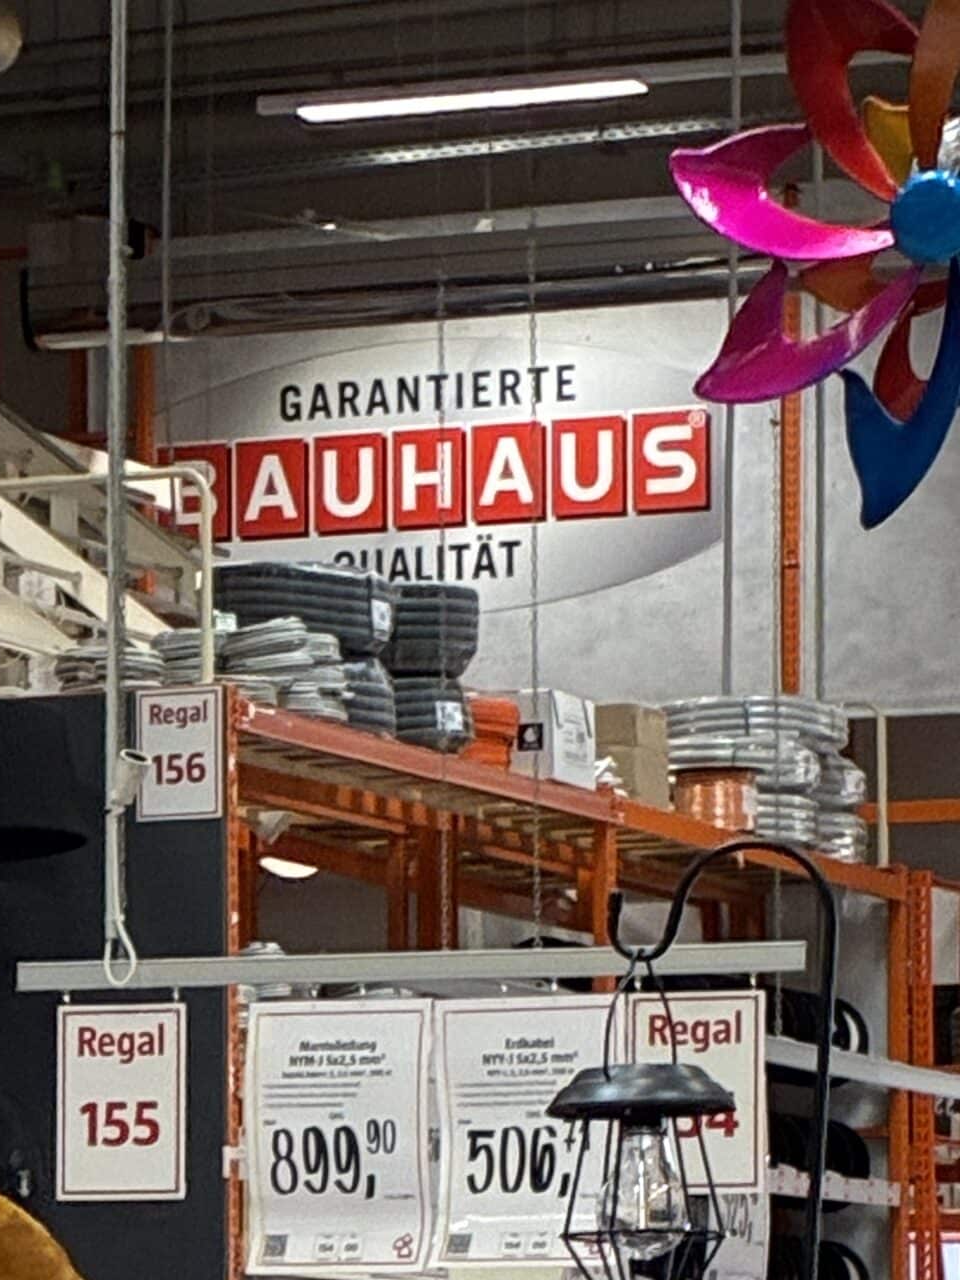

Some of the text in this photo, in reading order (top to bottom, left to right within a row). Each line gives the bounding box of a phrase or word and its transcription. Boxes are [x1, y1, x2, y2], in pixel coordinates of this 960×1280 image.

[279, 364, 577, 422] GARANTIERTE
[174, 420, 699, 527] BAUHAUS
[148, 700, 209, 729] Regal
[151, 752, 206, 785] 156
[77, 1021, 165, 1065] Regal
[647, 1010, 743, 1053] Regal
[79, 1100, 160, 1147] 155
